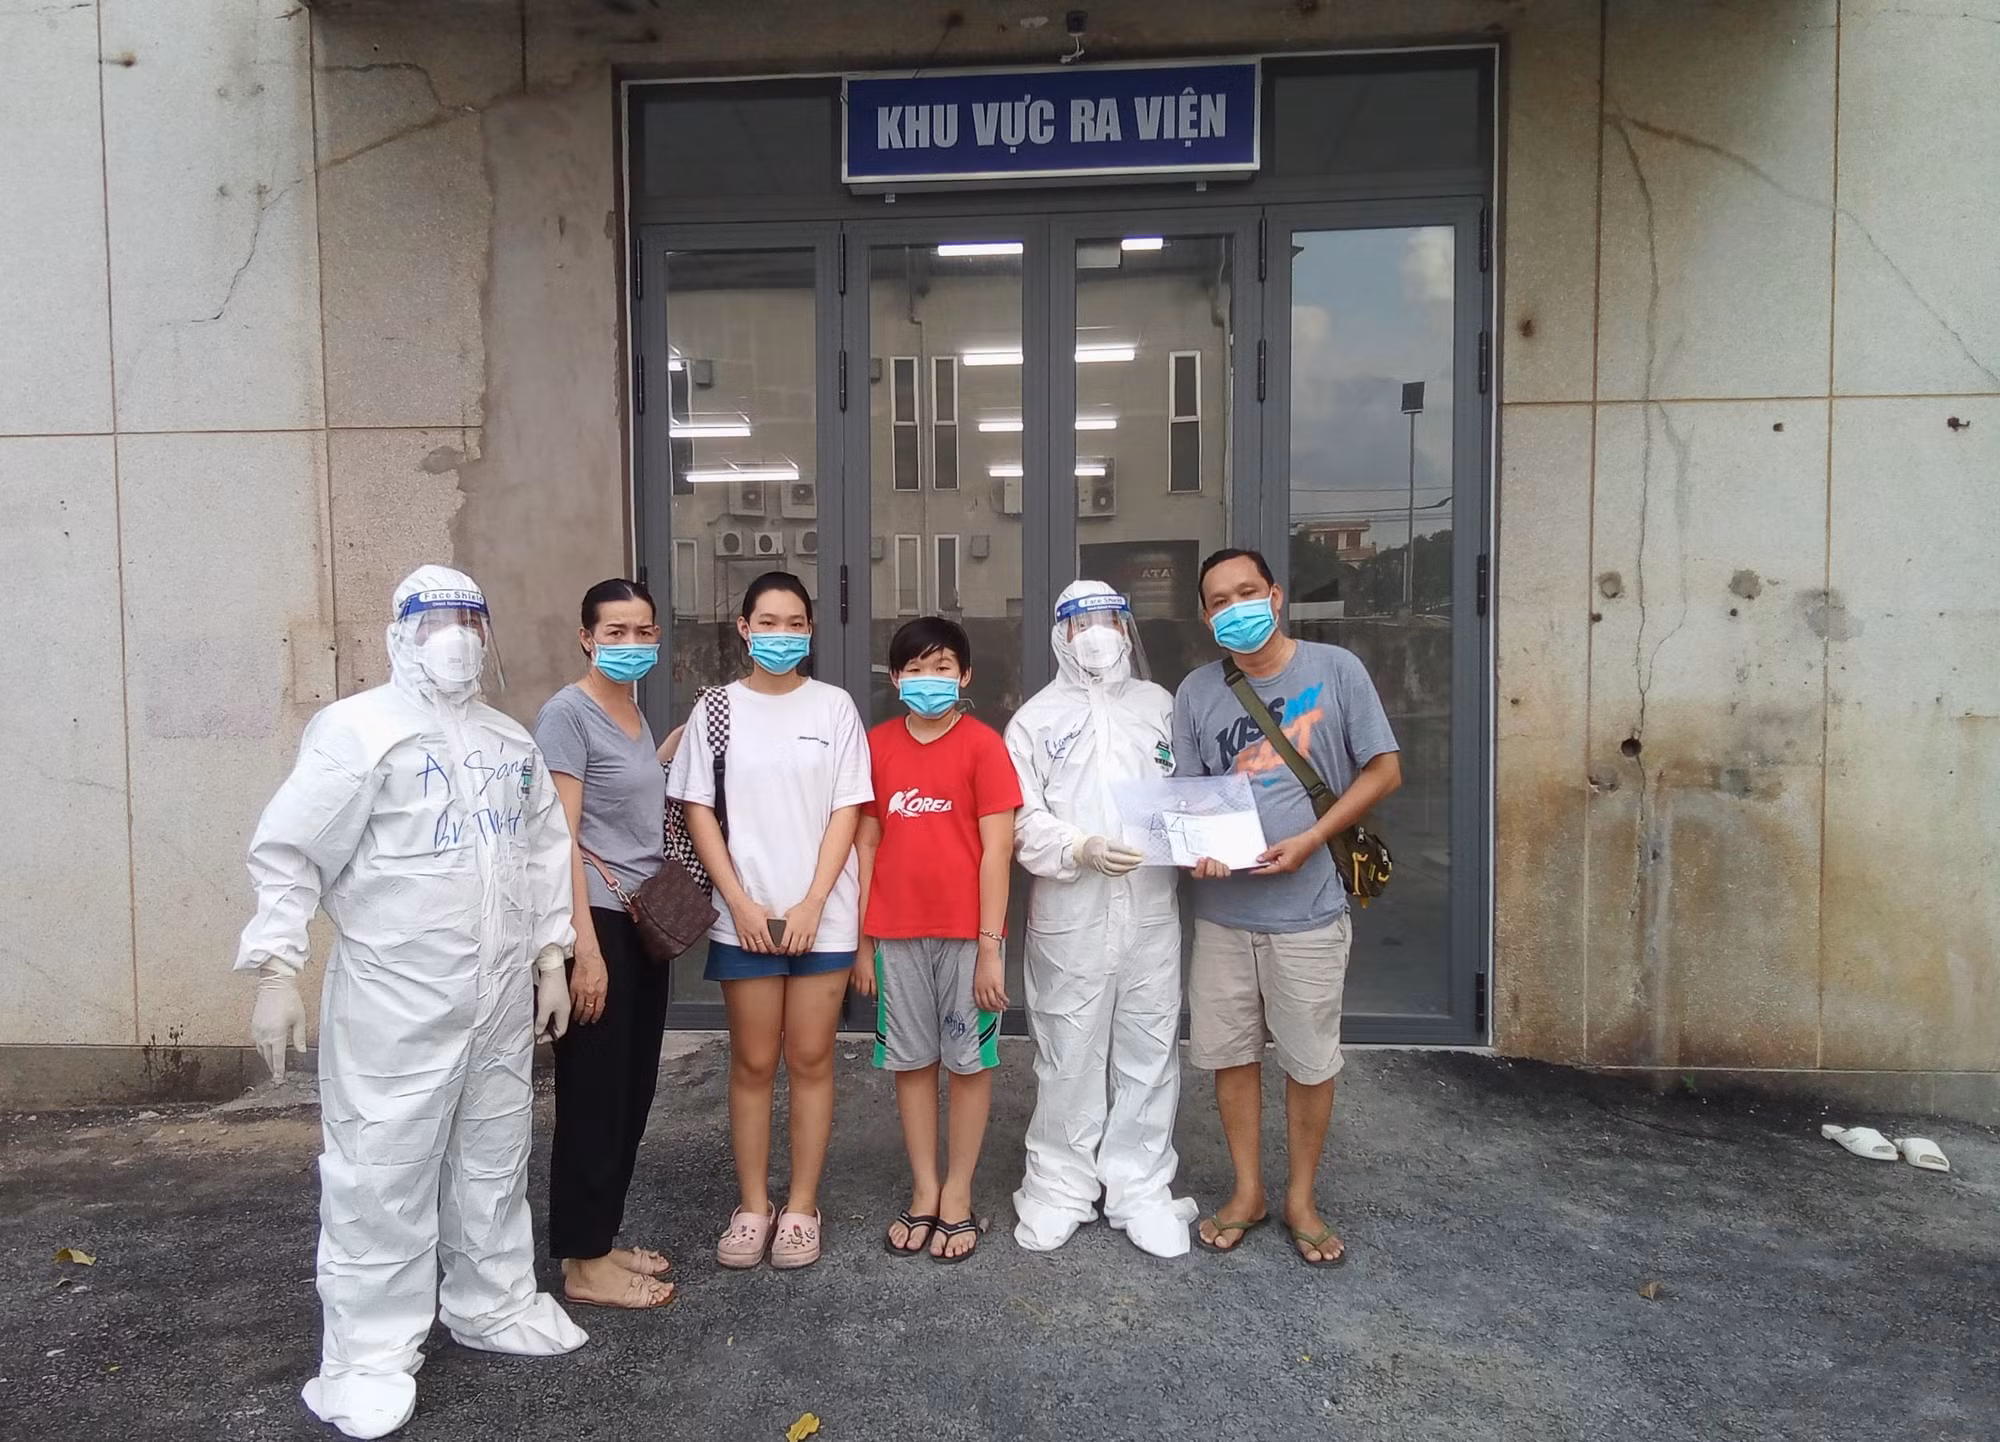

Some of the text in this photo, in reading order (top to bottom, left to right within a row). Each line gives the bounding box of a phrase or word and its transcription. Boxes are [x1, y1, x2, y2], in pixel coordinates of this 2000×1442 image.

[877, 86, 1227, 154] KHU VỰC RA VIỆN
[424, 592, 452, 601] Face
[416, 753, 451, 798] A
[887, 787, 953, 820] KOREA
